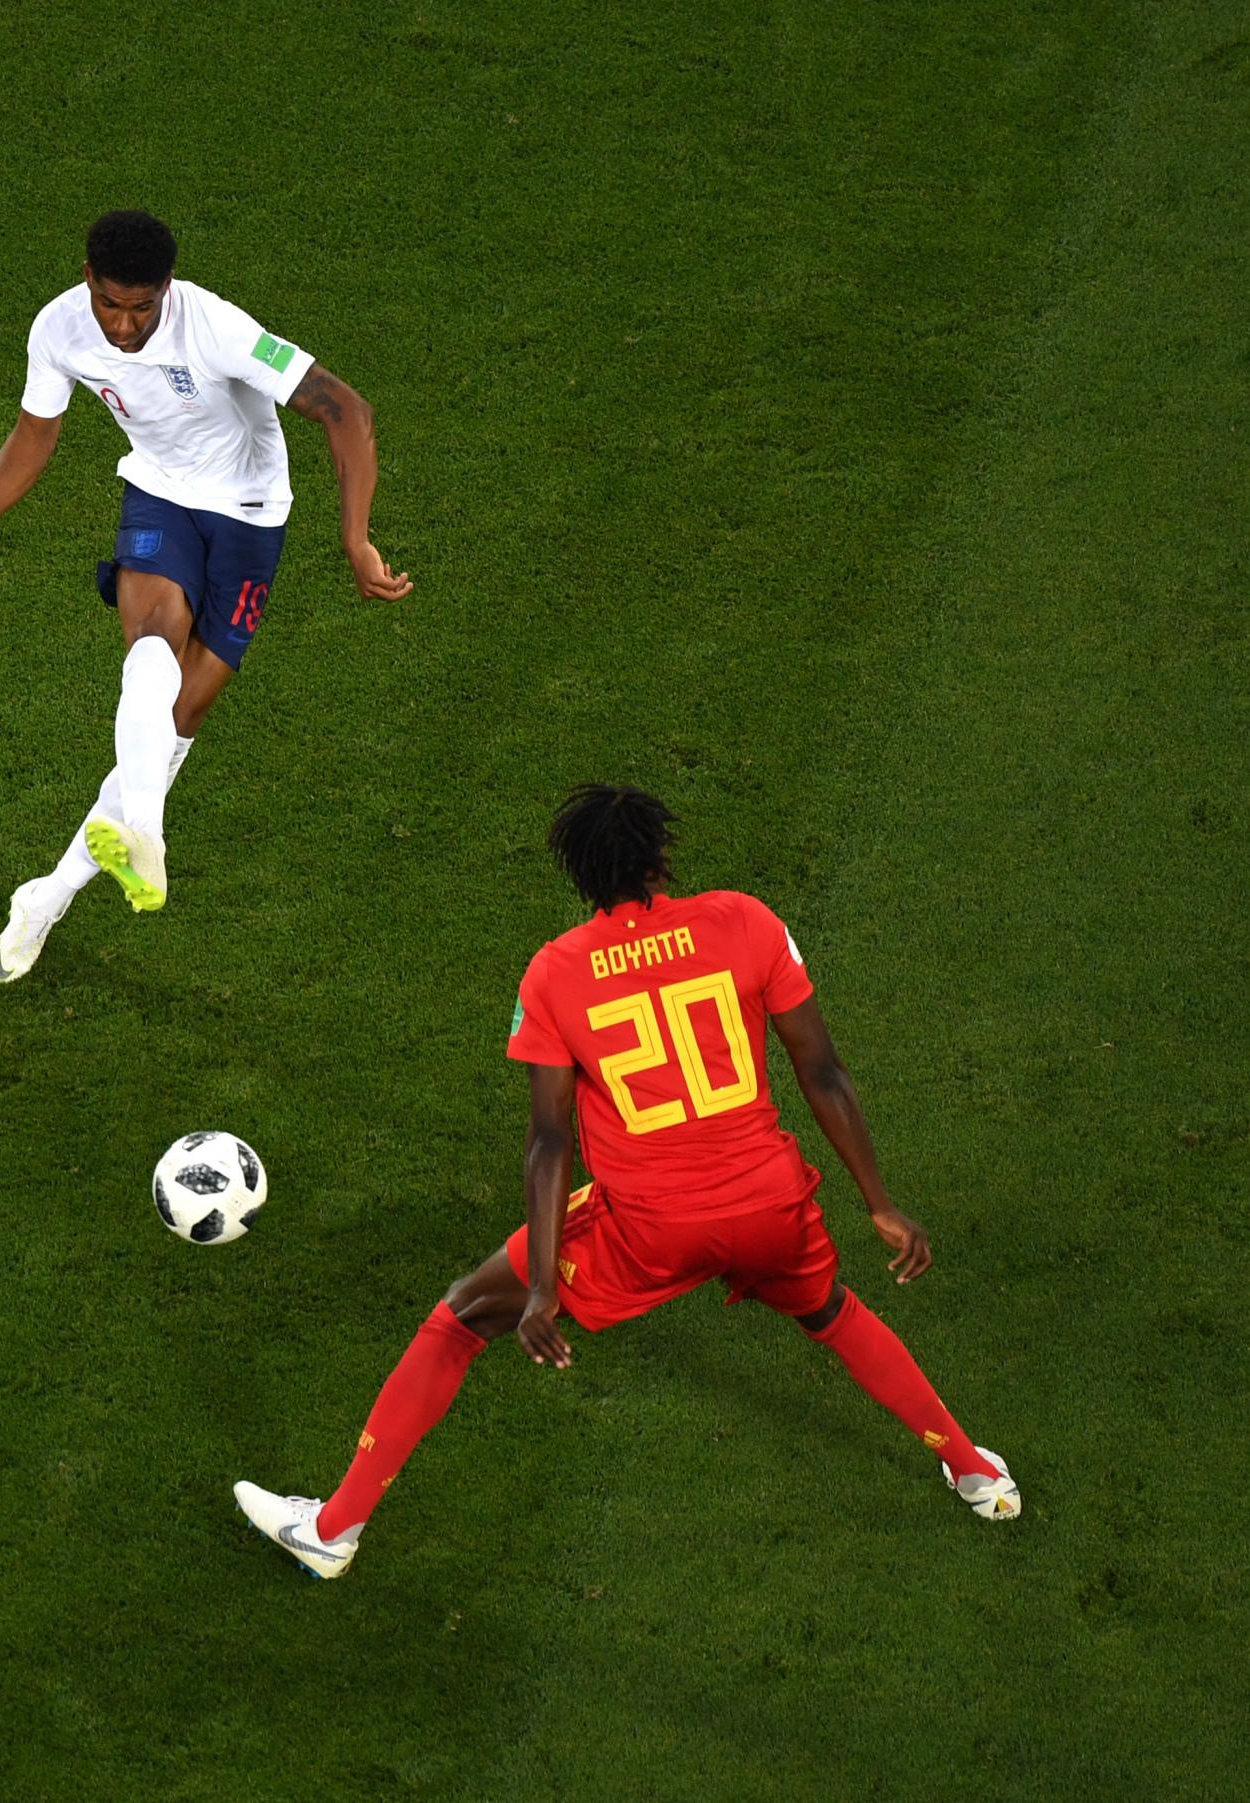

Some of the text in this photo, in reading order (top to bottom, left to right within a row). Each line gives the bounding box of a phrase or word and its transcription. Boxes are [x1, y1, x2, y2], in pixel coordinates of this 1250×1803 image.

[230, 580, 268, 632] 19
[590, 926, 696, 980] BOYATA
[586, 970, 758, 1135] 20
